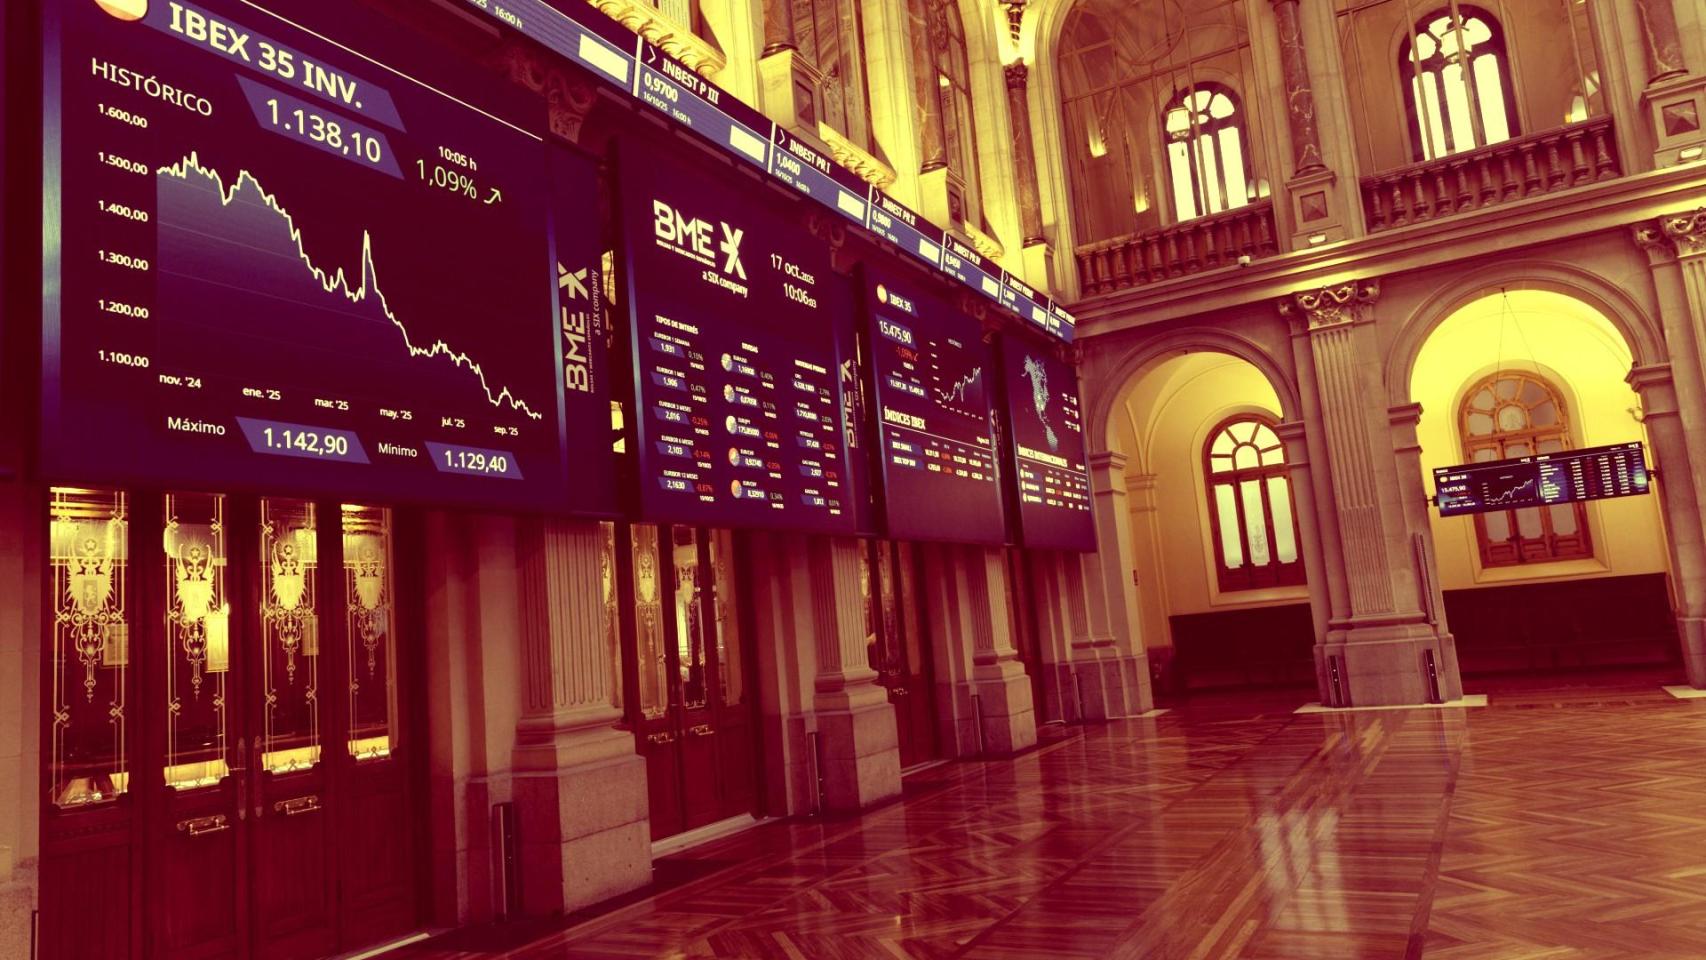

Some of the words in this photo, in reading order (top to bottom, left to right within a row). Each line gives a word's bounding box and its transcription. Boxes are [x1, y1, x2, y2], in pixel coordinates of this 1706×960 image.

[494, 6, 516, 26] 16:00
[169, 1, 250, 62] IBEX
[258, 42, 296, 79] 35
[302, 60, 362, 109] INV.
[92, 57, 213, 117] HISTÓRICO
[644, 72, 678, 103] 0,9700
[662, 58, 699, 91] INBEST
[699, 83, 707, 96] P
[707, 88, 719, 105] III
[98, 103, 148, 128] 1.600,00
[267, 99, 382, 163] 1.138,10
[98, 151, 149, 176] 1.500,00
[439, 146, 468, 167] 10:05
[469, 157, 477, 171] h
[789, 139, 816, 166] INBEST
[416, 159, 477, 199] 1,09%
[98, 199, 149, 222] 1.400,00
[653, 199, 716, 259] BME
[98, 250, 149, 271] 1.300,00
[770, 252, 782, 270] 17
[590, 269, 600, 309] company
[719, 277, 748, 298] company
[98, 299, 149, 319] 1.200,00
[593, 312, 601, 328] SIX
[879, 320, 912, 344] 15.475,90
[98, 350, 149, 368] 1.100,00
[562, 306, 590, 393] BME
[159, 374, 183, 387] nov.
[185, 376, 203, 389] '24
[242, 386, 265, 399] ene.
[266, 388, 281, 401] '25
[315, 397, 334, 409] mar.
[335, 399, 350, 410] '25
[379, 407, 399, 419] may.
[400, 409, 413, 420] '25
[441, 416, 453, 428] jul.
[454, 417, 466, 428] '25
[168, 416, 226, 436] Máximo
[494, 425, 509, 437] sep.
[509, 425, 520, 437] '25
[264, 427, 348, 457] 1.142,90
[378, 442, 418, 457] Mínimo
[444, 450, 508, 474] 1.129,40
